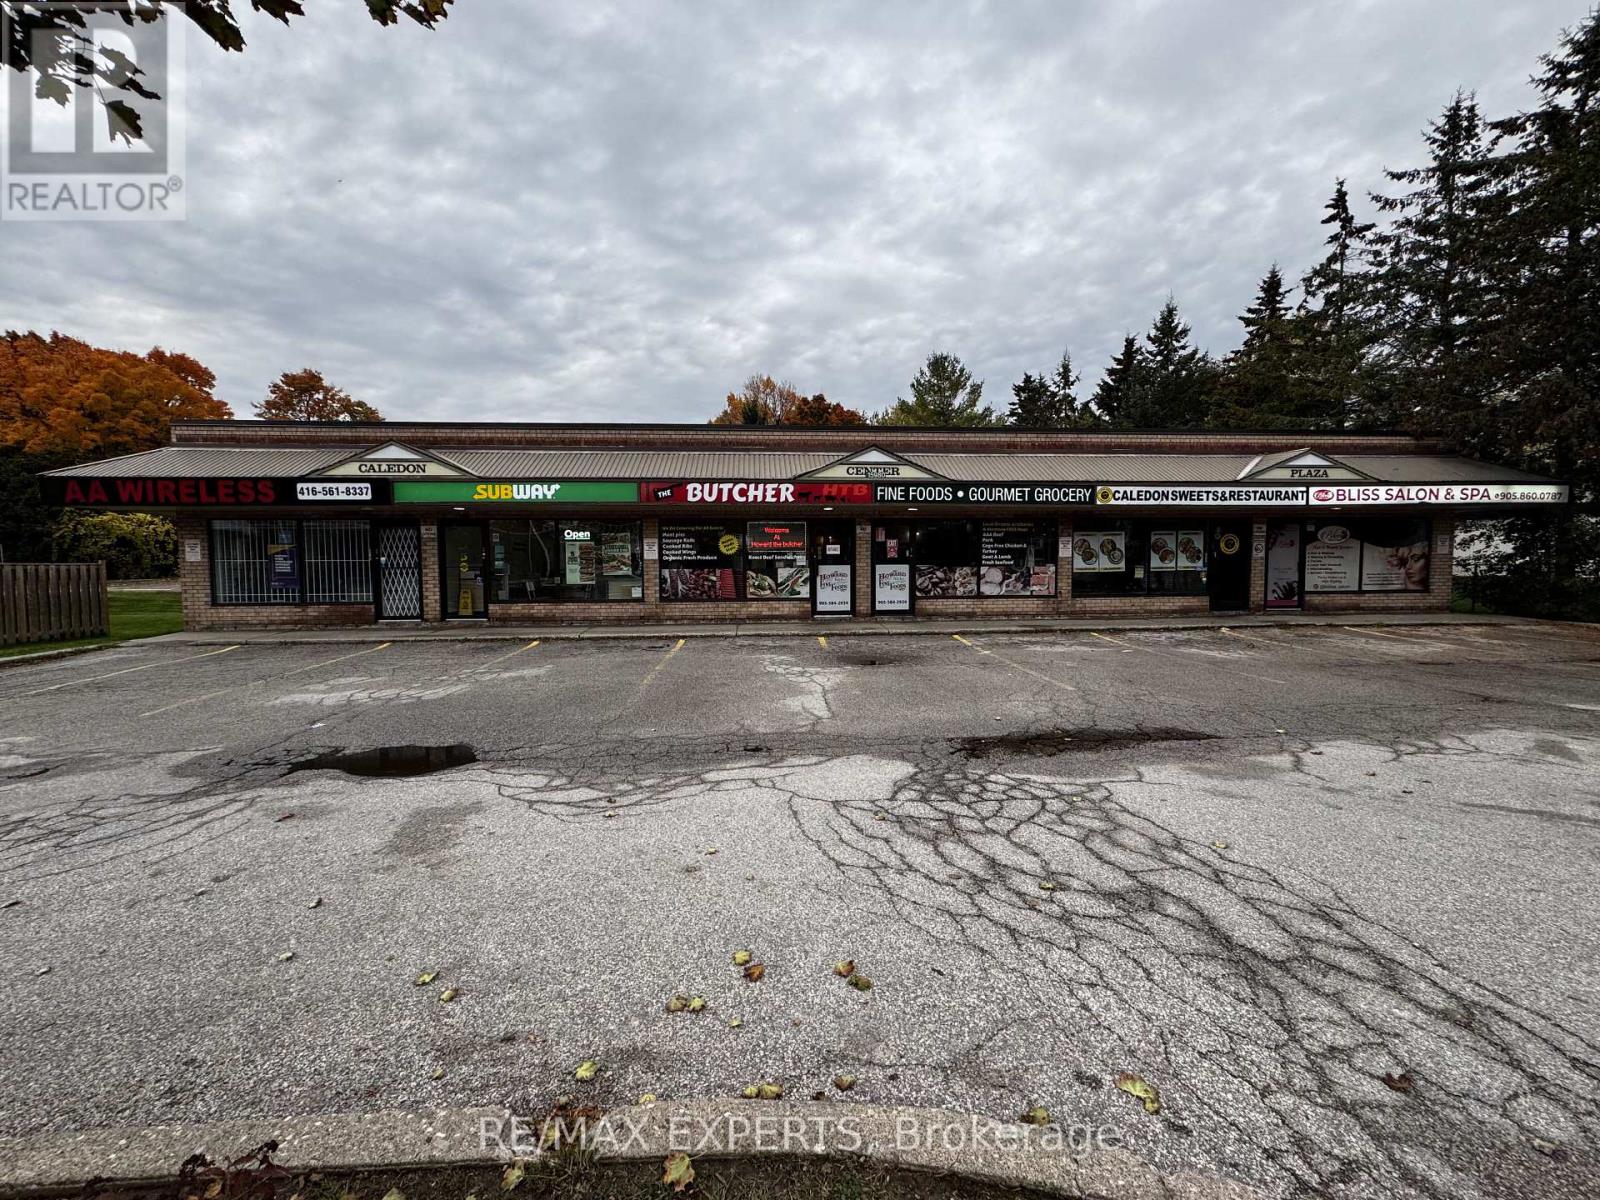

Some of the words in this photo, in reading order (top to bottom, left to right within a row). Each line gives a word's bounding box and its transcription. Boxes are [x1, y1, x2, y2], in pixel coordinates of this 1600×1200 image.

[358, 463, 427, 474] CALEDON
[846, 466, 901, 476] CENTER
[1290, 468, 1329, 478] PLAZA
[65, 480, 108, 503] AA
[116, 479, 276, 503] WIRELESS
[298, 485, 370, 498] 416-561-8337
[473, 484, 561, 500] SUBWAY
[657, 489, 672, 498] THE
[686, 483, 795, 503] BUTCHER
[822, 484, 868, 496] HTB
[877, 486, 905, 501] FINE
[909, 487, 953, 501] FOODS
[968, 487, 1031, 502] GOURMET
[1034, 487, 1092, 502] GROCERY
[1336, 488, 1380, 502] BLISS
[1384, 487, 1440, 501] SALON
[1443, 488, 1455, 501] &
[1459, 487, 1491, 501] SPA
[1499, 491, 1563, 501] 905.860.0787
[564, 529, 591, 540] Open
